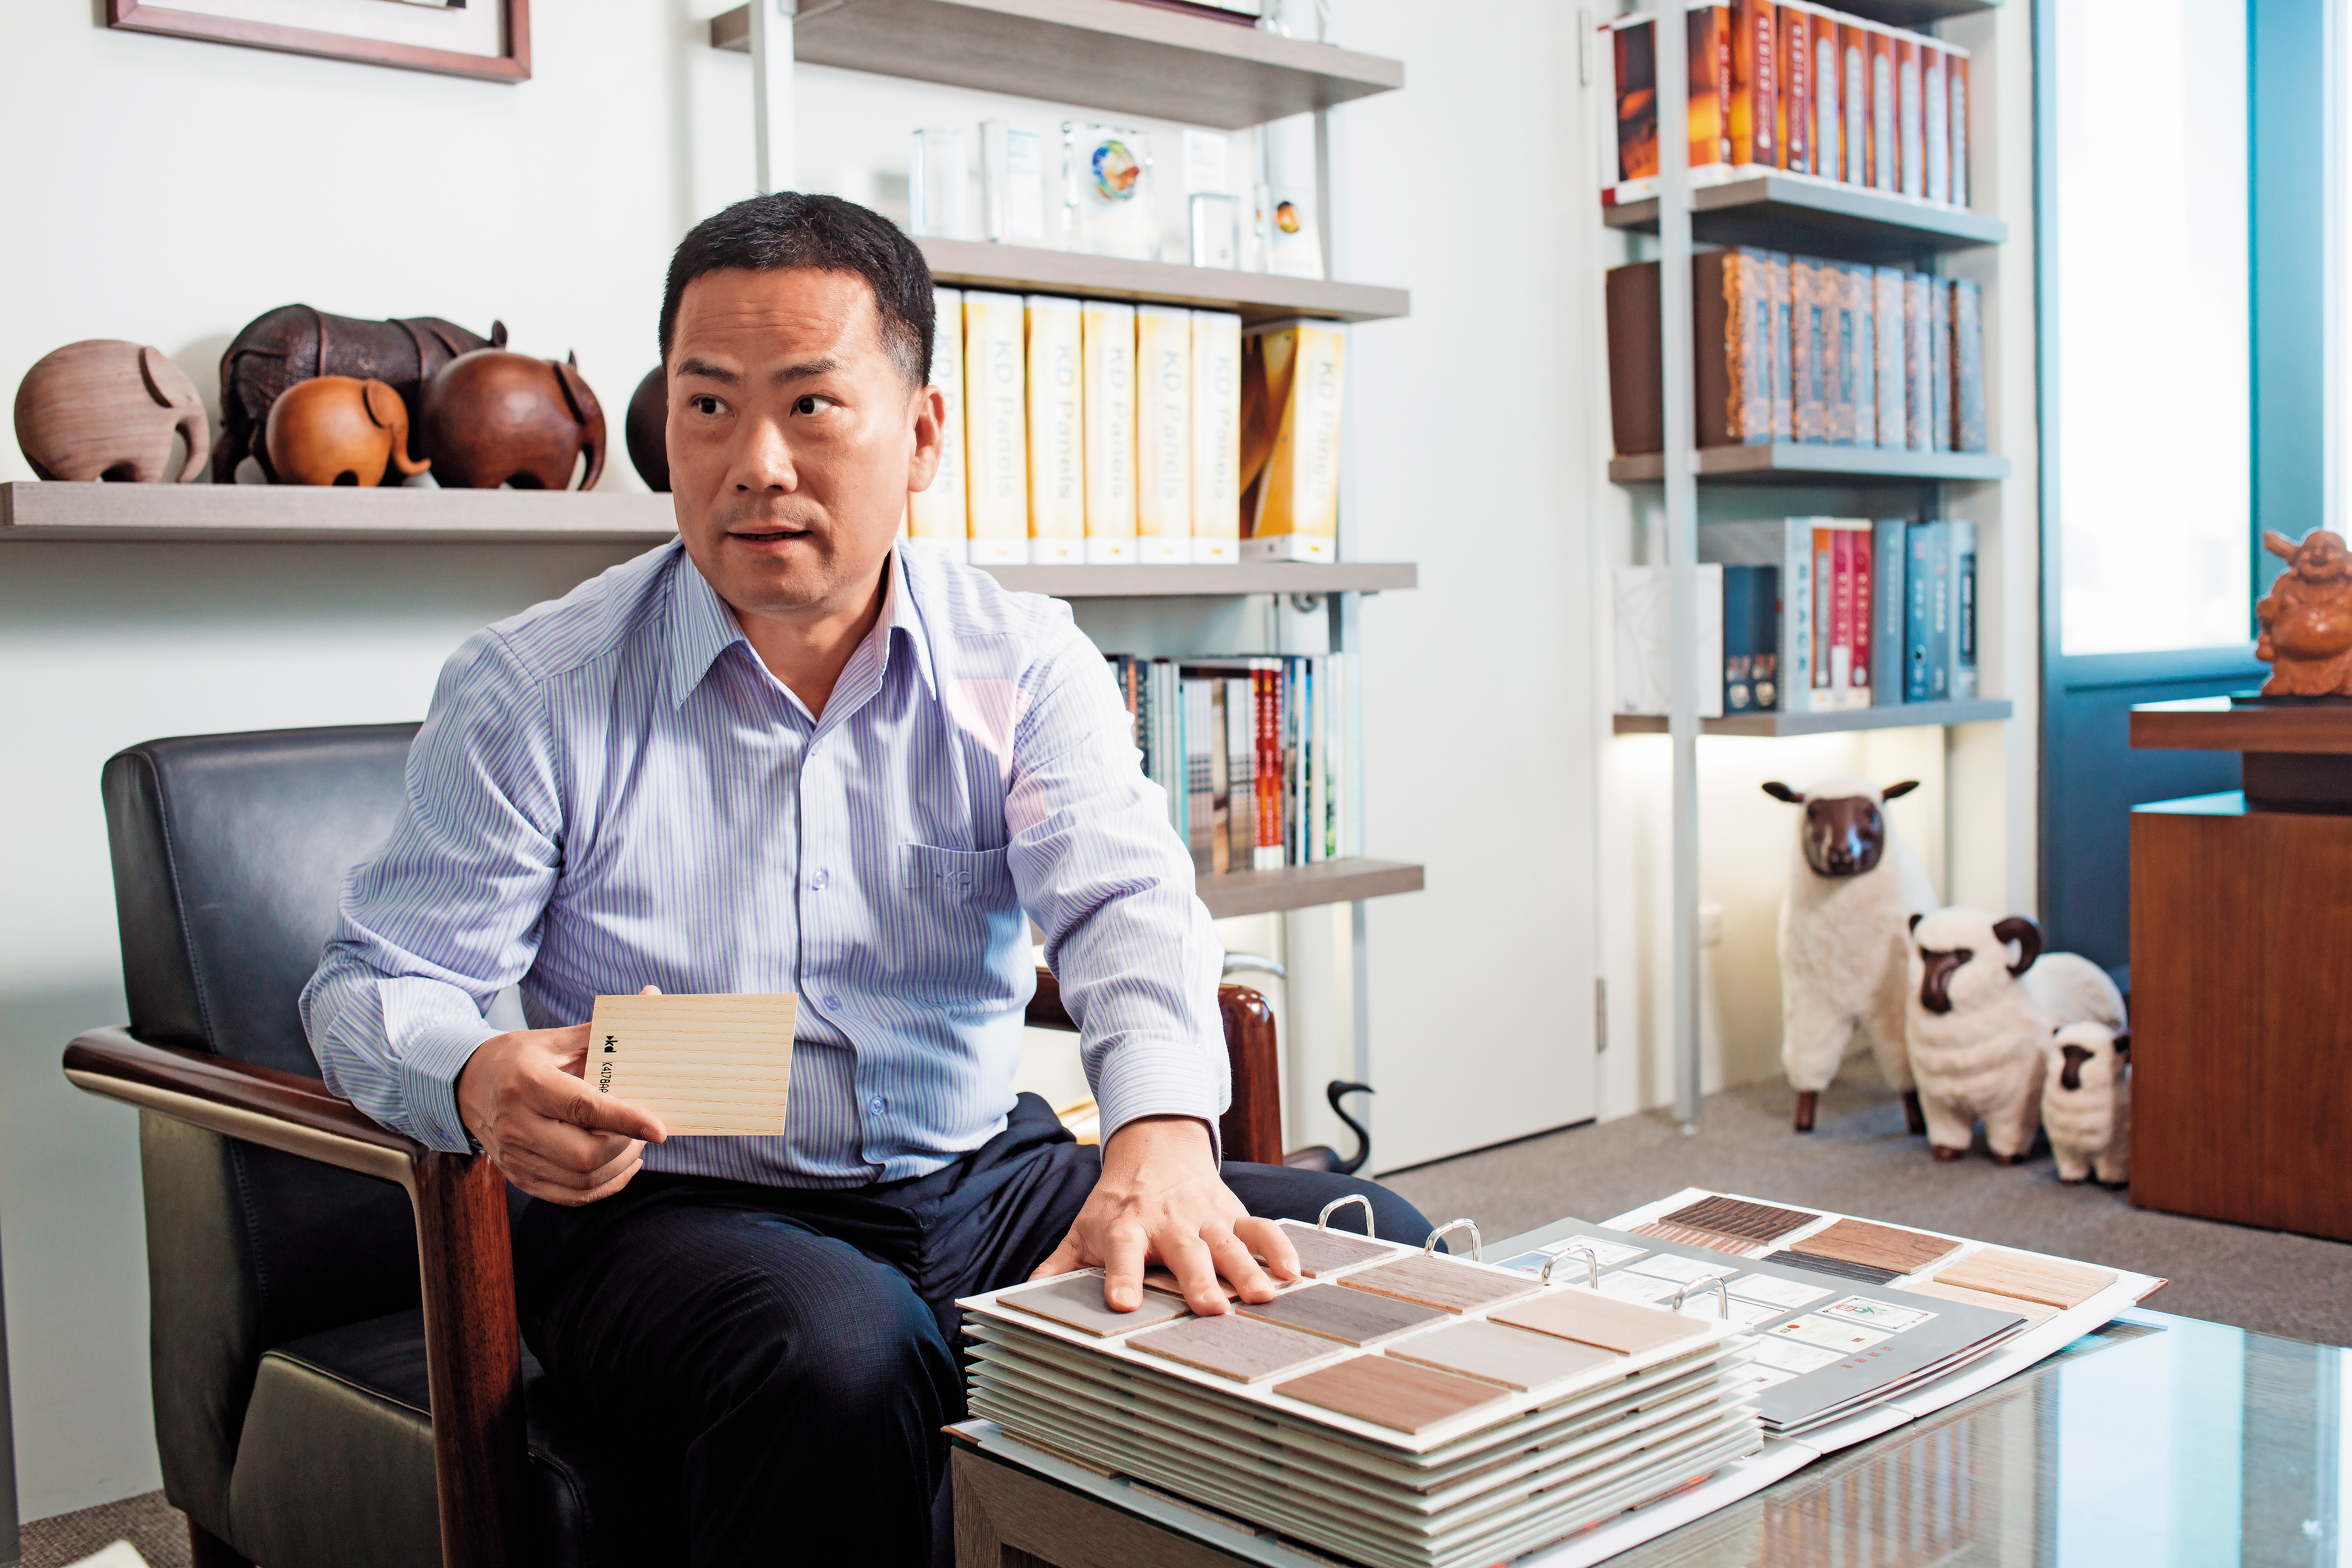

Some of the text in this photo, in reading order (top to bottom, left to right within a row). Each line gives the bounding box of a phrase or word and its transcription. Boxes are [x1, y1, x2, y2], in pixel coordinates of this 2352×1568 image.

[936, 335, 954, 378] KD
[994, 340, 1016, 497] KD Panels
[1055, 345, 1075, 499] KD Panels
[1109, 347, 1129, 498] KD Panels
[1163, 351, 1183, 498] KD Panels
[1214, 355, 1233, 499] KD Panels
[1316, 361, 1337, 499] KD Panels
